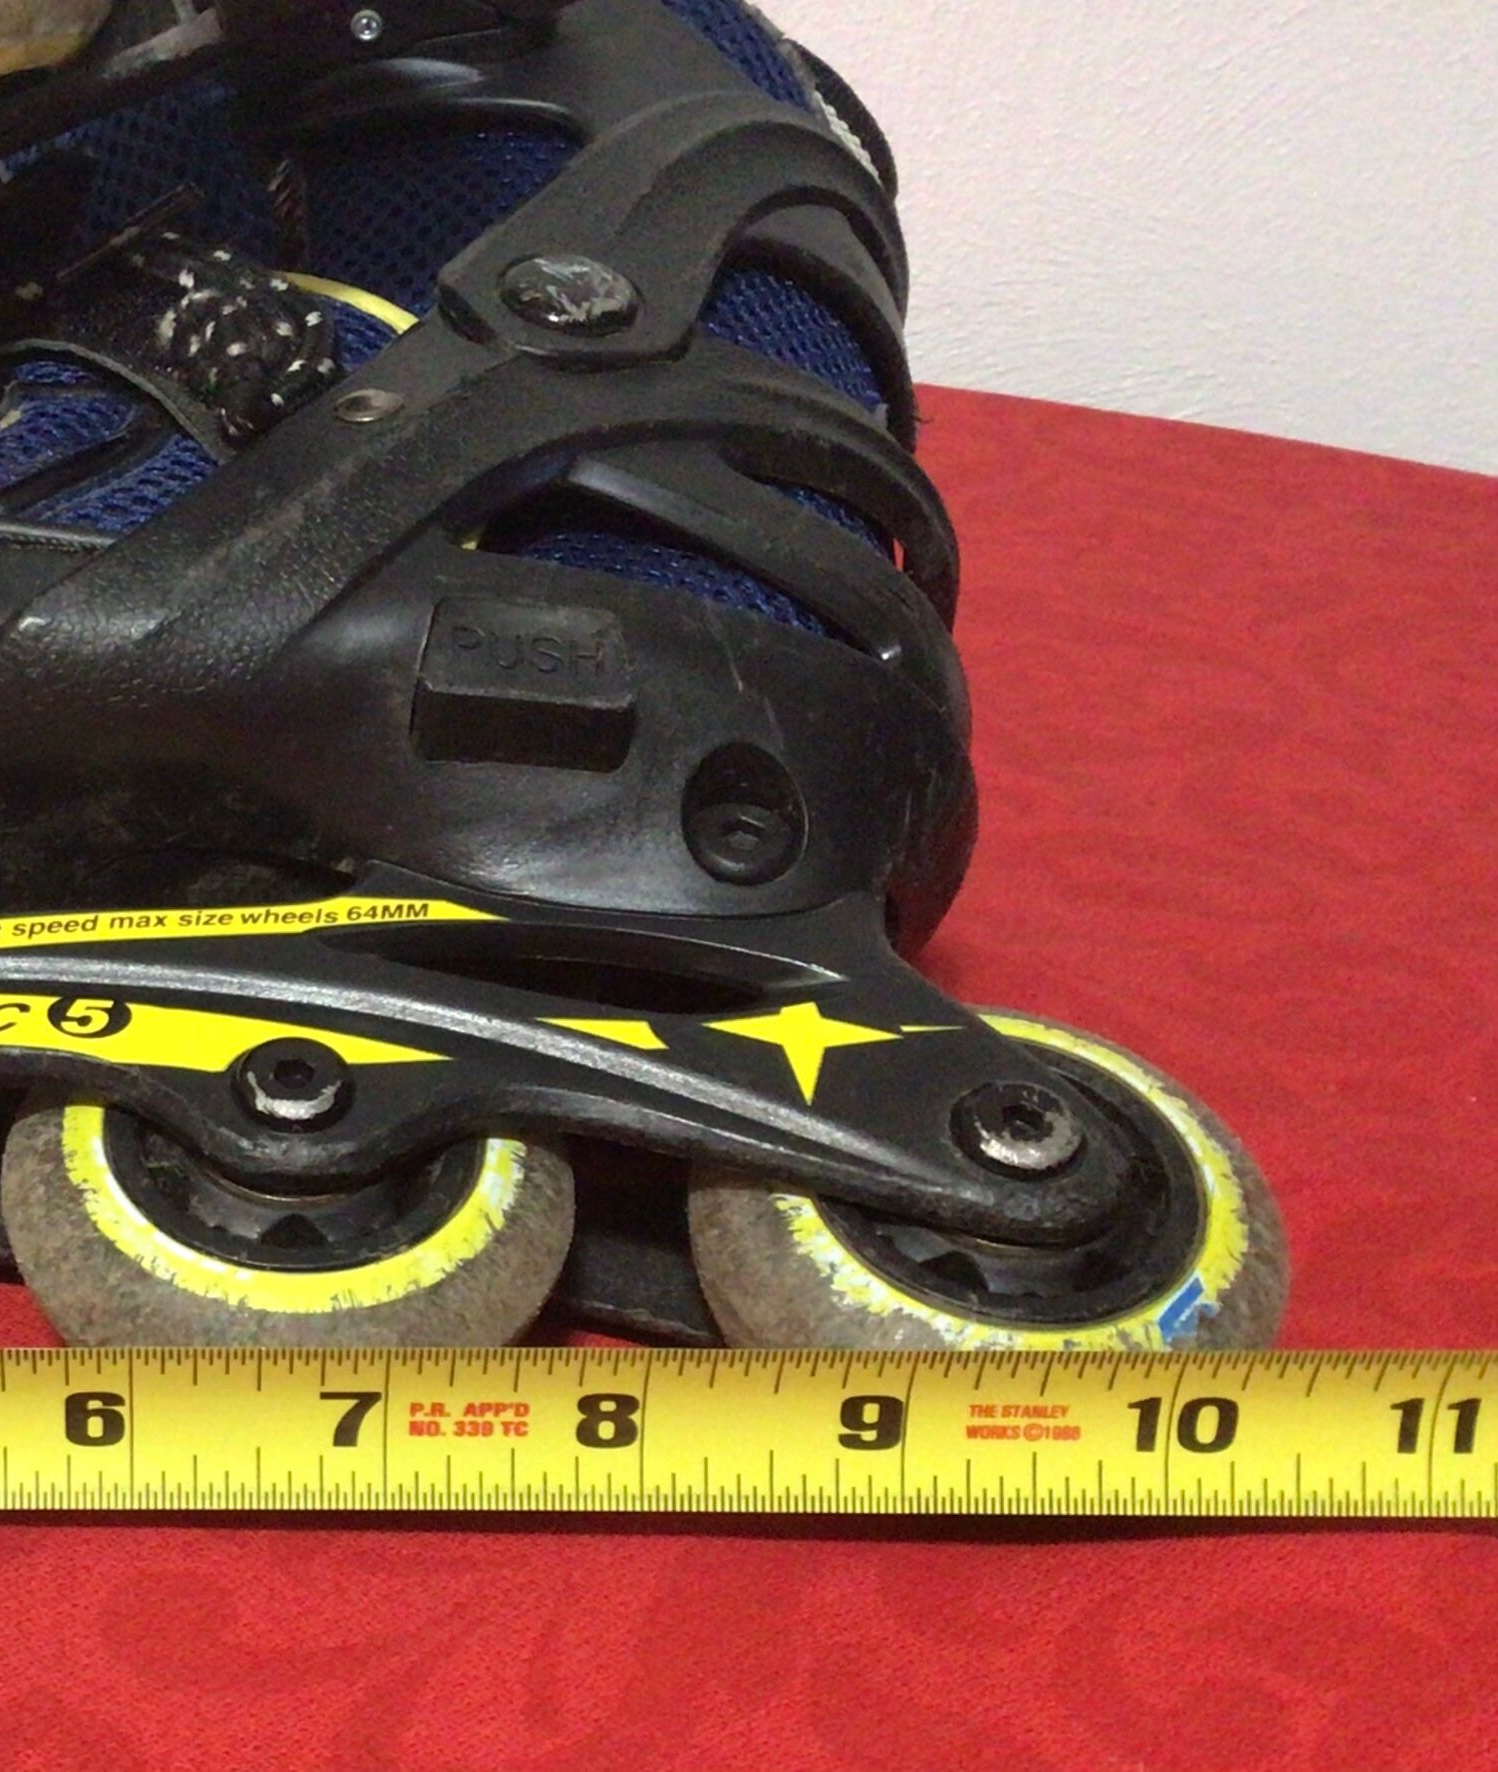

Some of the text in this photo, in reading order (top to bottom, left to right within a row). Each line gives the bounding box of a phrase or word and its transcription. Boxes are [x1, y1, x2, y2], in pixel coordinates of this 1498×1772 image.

[450, 624, 606, 676] PUSH
[12, 914, 99, 940] speed
[109, 914, 168, 930] max
[178, 910, 233, 928] size
[241, 907, 339, 925] wheels
[347, 902, 430, 921] 64MM
[60, 998, 114, 1034] 5
[64, 1392, 126, 1446] 6
[319, 1391, 383, 1447] 7
[409, 1402, 530, 1418] P.R. APP'D
[409, 1420, 447, 1437] NO.
[500, 1420, 529, 1437] TC
[575, 1393, 640, 1448] 8
[838, 1395, 903, 1450] 9
[966, 1424, 1021, 1440] WORKS
[969, 1404, 1069, 1418] THE STANLEY
[1127, 1397, 1239, 1453] 10
[1390, 1397, 1482, 1454] 11
